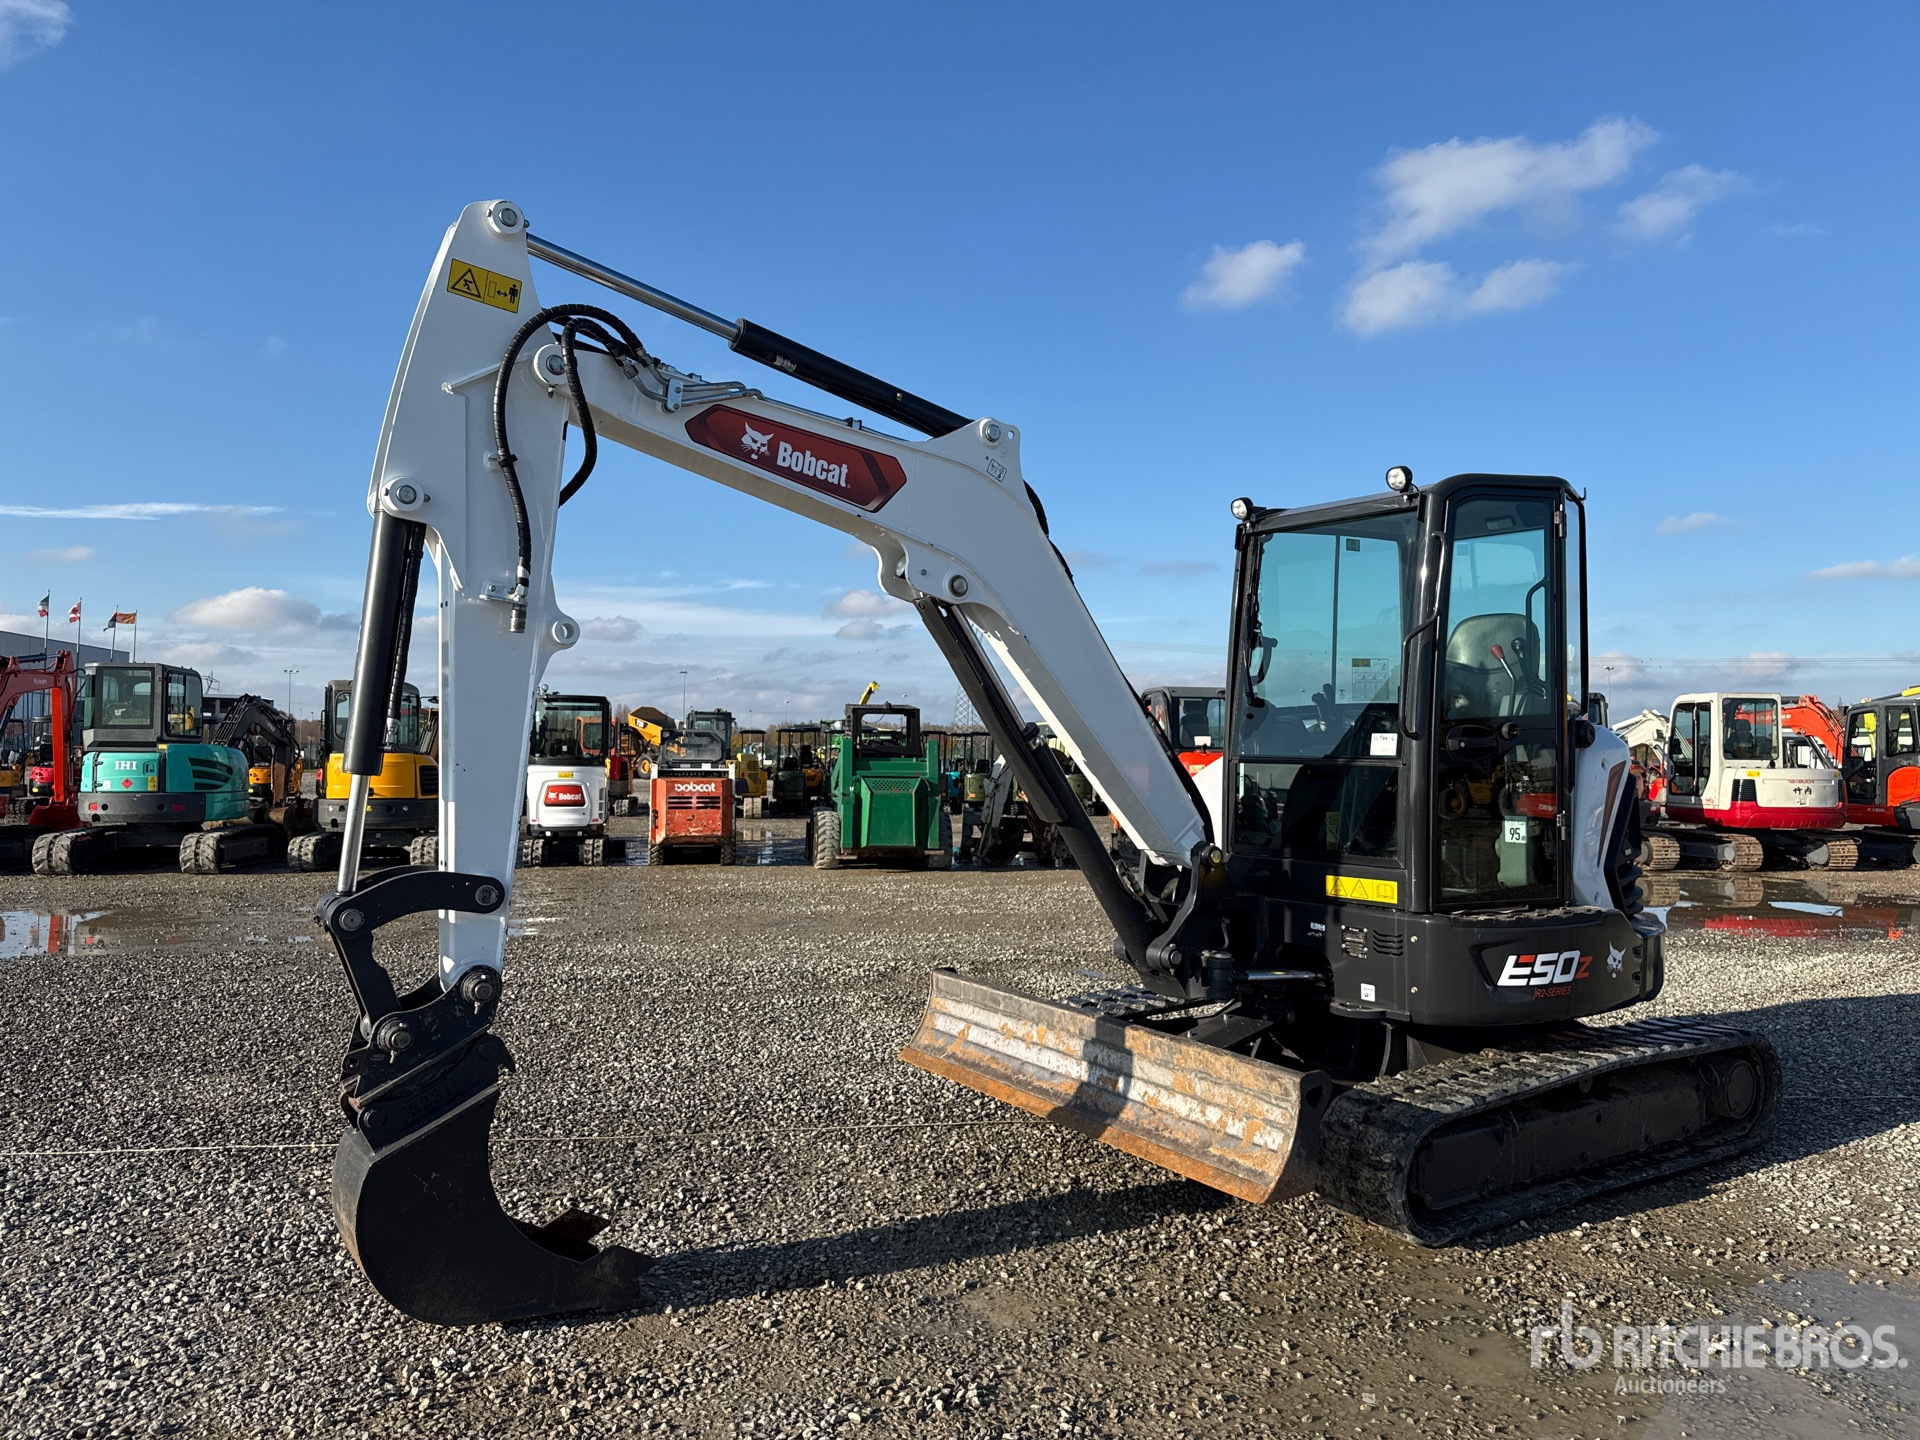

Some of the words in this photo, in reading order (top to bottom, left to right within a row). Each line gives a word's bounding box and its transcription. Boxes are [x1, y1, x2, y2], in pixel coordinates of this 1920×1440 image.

[776, 441, 849, 488] Bobcat
[114, 760, 137, 770] IHI
[558, 793, 582, 801] Bobcat
[1509, 827, 1521, 841] 95
[1535, 986, 1573, 998] R2-SERIES
